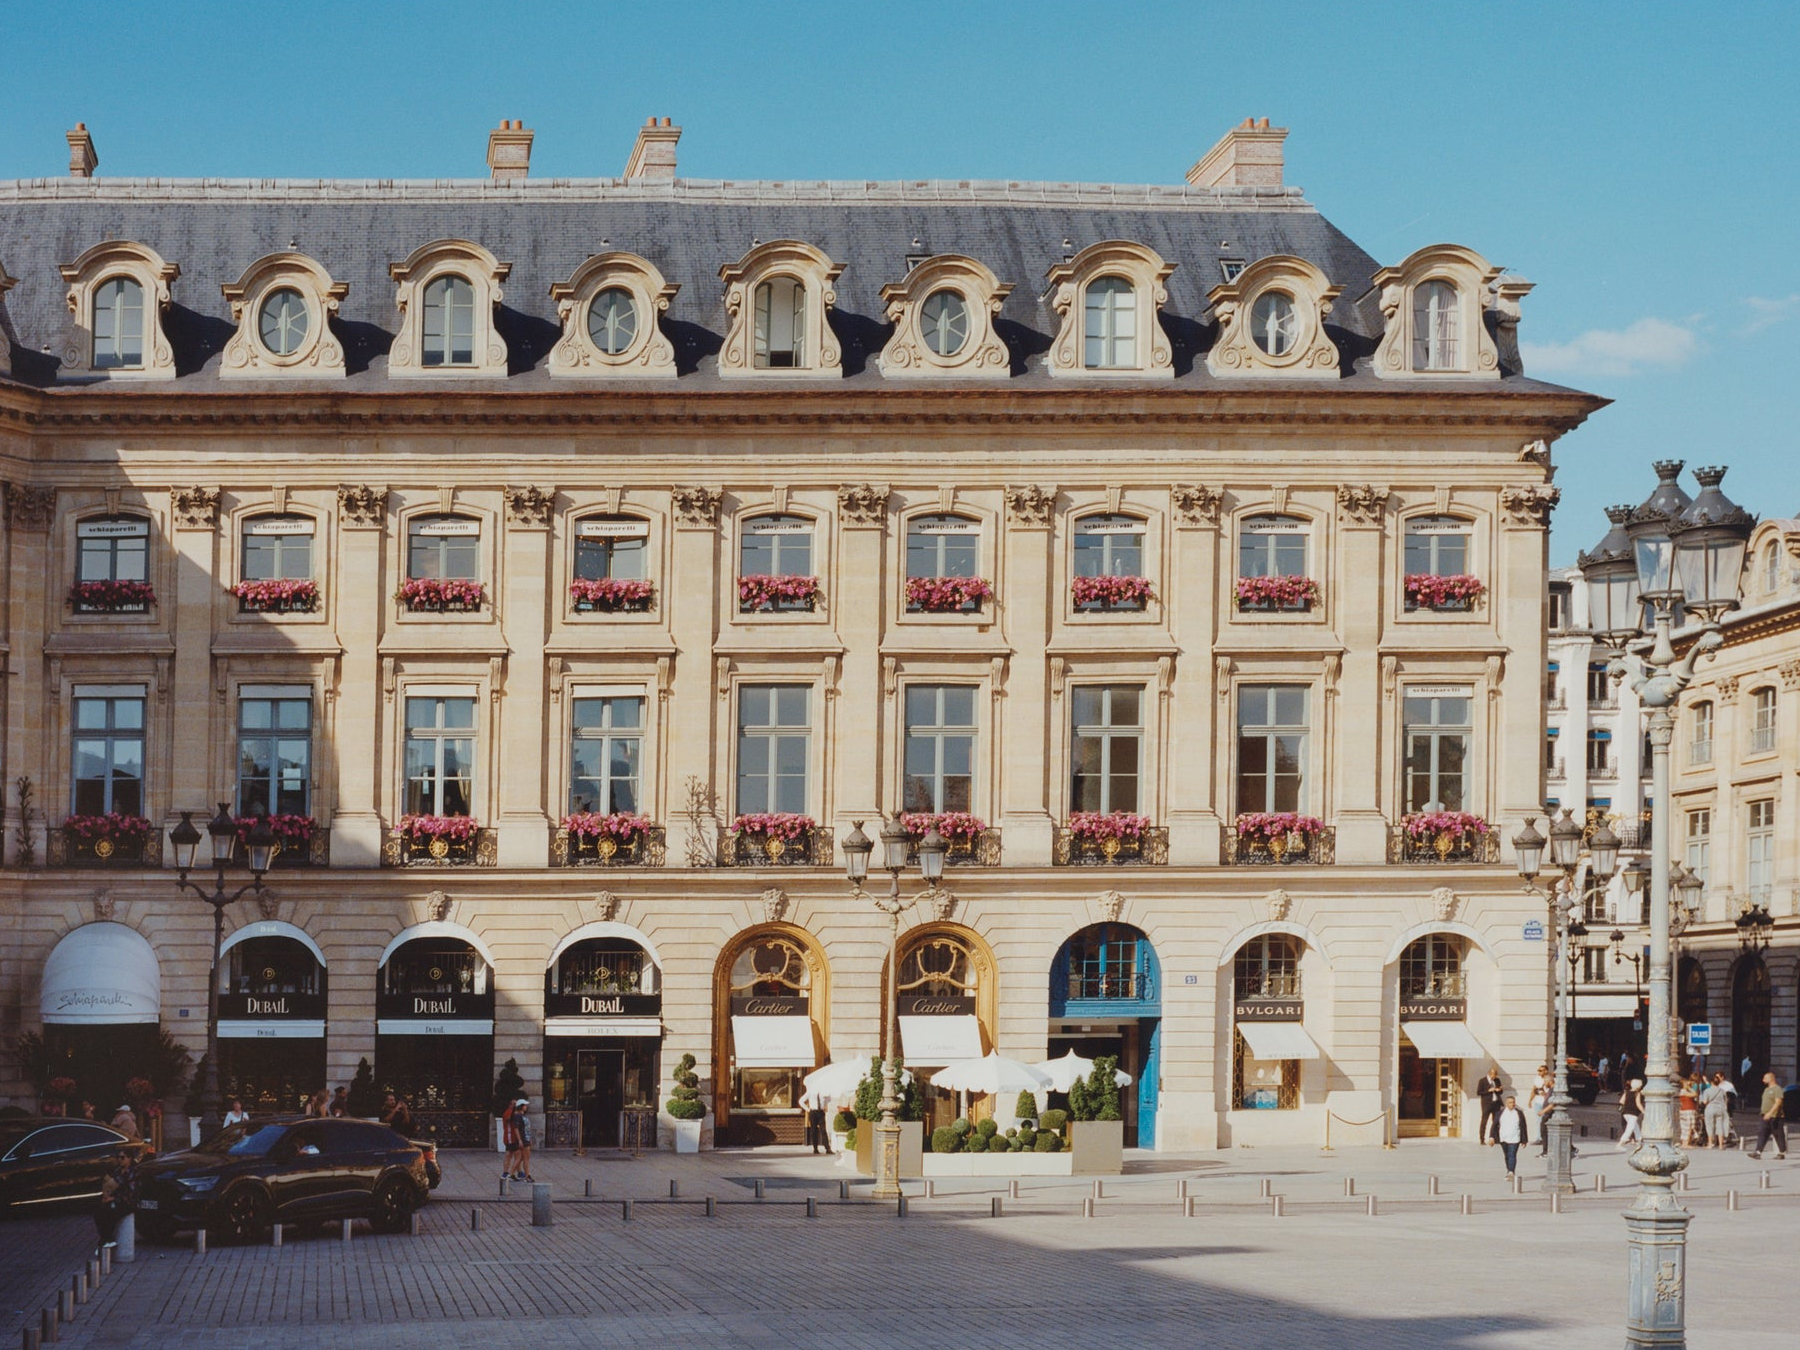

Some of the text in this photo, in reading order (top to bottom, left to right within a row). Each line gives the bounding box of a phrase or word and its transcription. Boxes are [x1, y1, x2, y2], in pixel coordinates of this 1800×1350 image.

[247, 997, 289, 1014] DUBAIL
[414, 997, 456, 1014] DUBAIL
[581, 996, 624, 1013] DUBAIL
[745, 999, 793, 1014] Cartier
[912, 998, 960, 1013] Cartier
[1236, 1006, 1301, 1015] BVLGARI
[1400, 1005, 1464, 1014] BVLGARI
